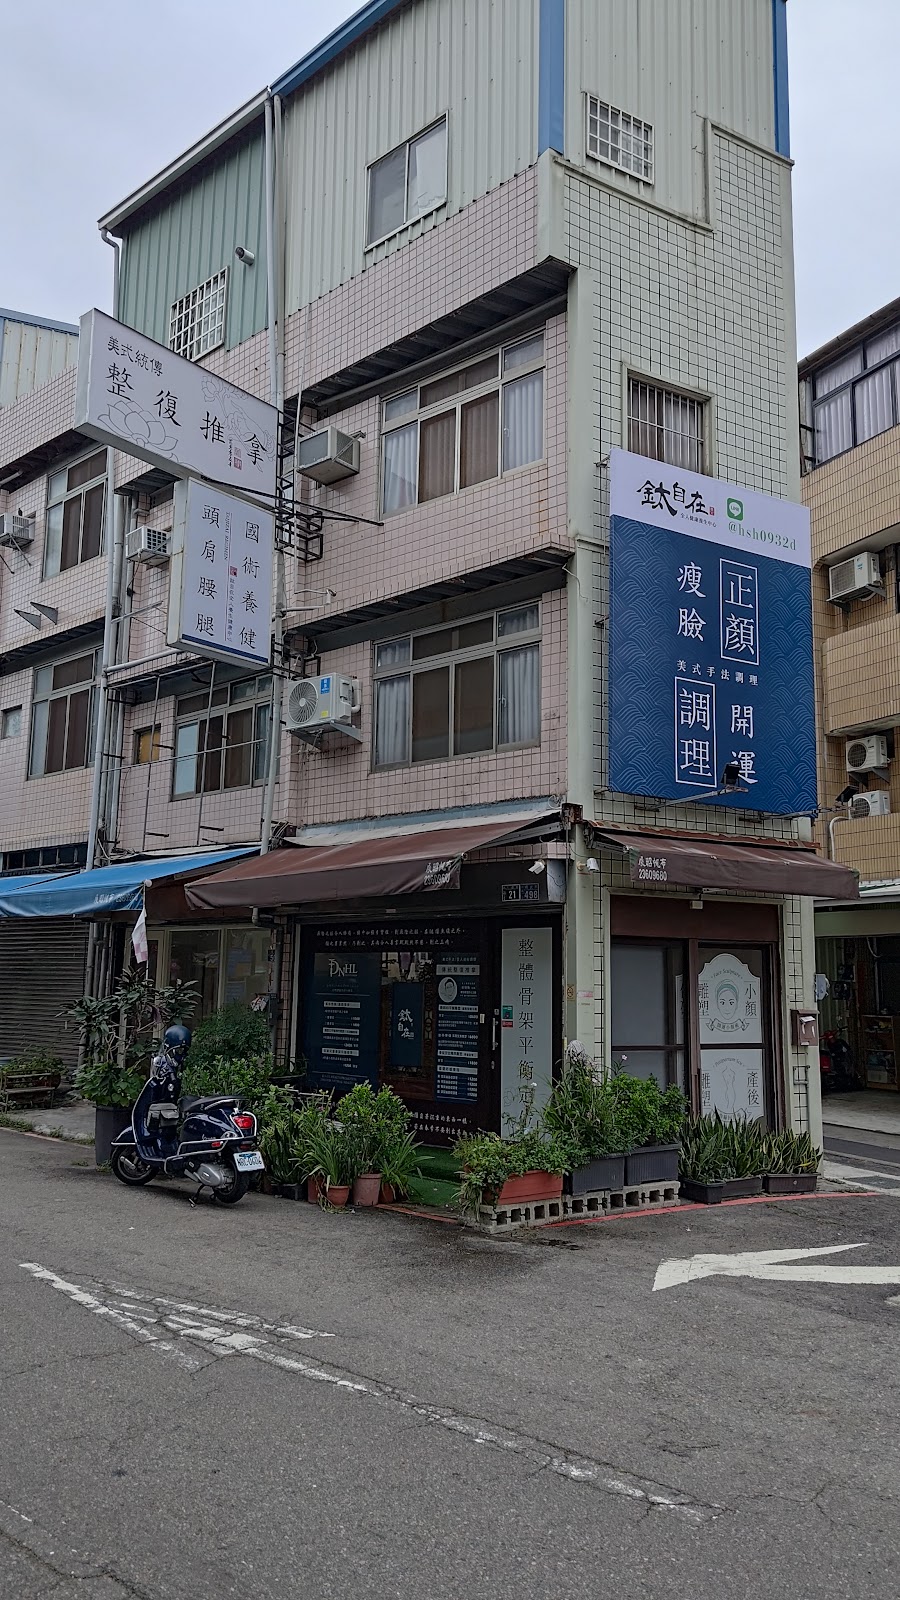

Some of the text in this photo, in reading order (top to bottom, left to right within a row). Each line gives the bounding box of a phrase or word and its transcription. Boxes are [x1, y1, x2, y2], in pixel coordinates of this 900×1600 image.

[105, 362, 268, 466] 整復推拿
[636, 480, 709, 517] 鈦自在
[728, 521, 797, 552] @hsh0932d
[195, 504, 221, 637] 頭肩腰腿
[239, 520, 261, 650] 國術養健
[676, 561, 707, 642] 瘦臉
[724, 570, 755, 656] 正顏
[676, 659, 759, 687] 美式手法調理
[679, 687, 713, 779] 調理
[730, 704, 759, 784] 開運
[508, 890, 517, 899] 21
[524, 890, 538, 899] 498
[744, 983, 757, 1016] 小顏
[747, 1071, 760, 1106] 產後
